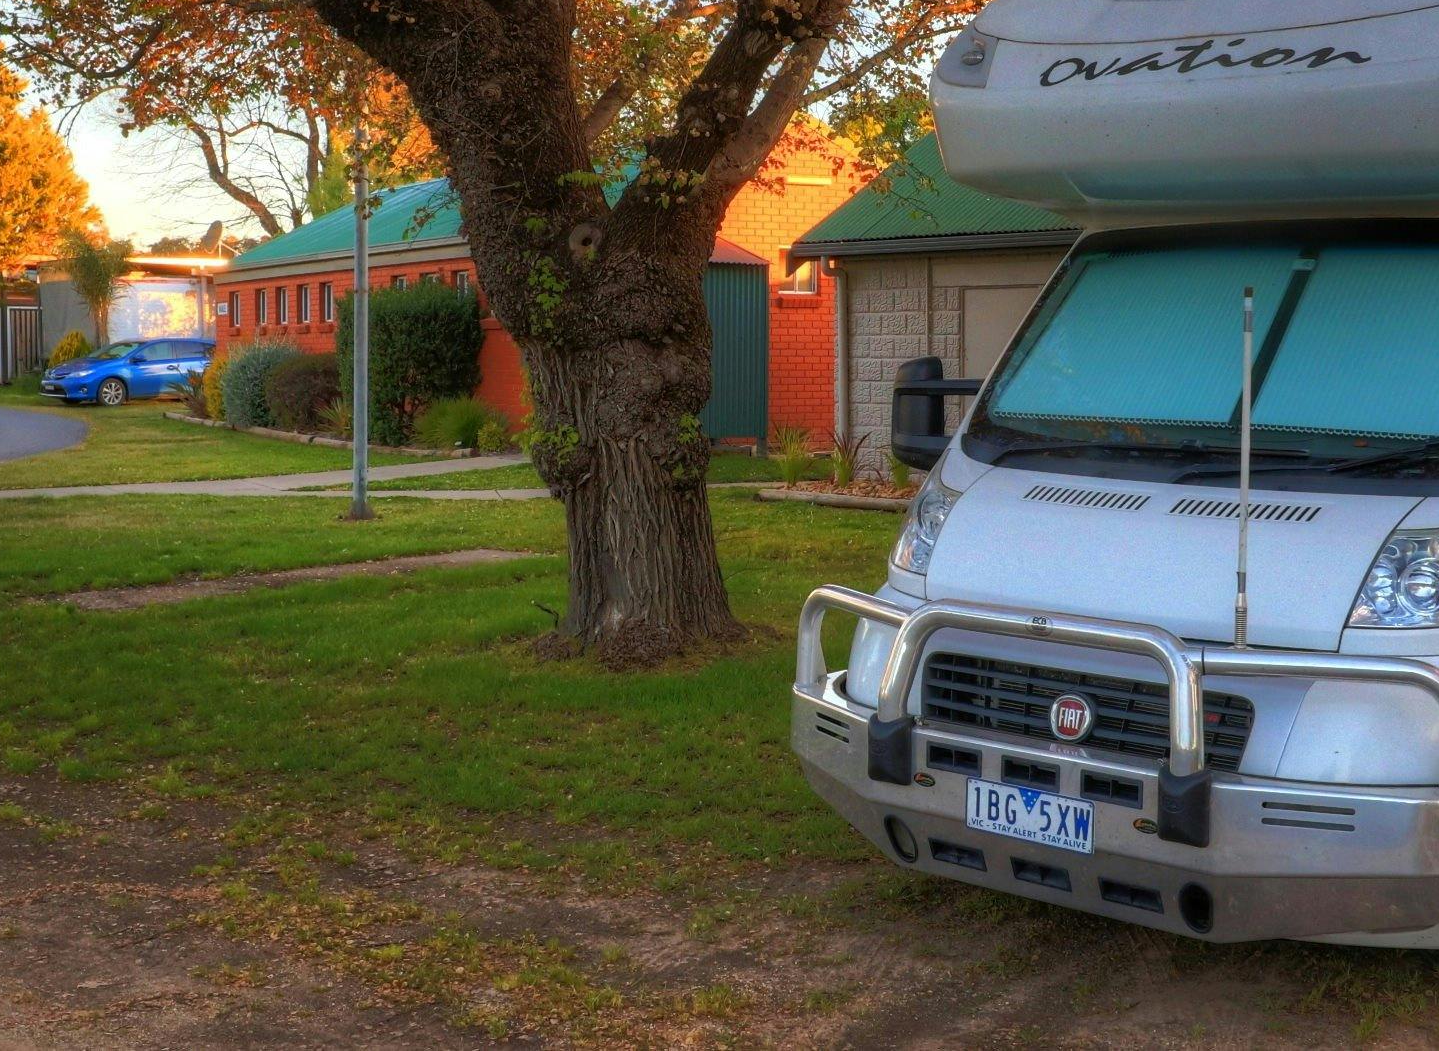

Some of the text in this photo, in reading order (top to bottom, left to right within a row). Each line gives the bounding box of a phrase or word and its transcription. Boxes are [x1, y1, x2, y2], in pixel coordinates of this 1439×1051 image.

[1058, 706, 1083, 730] FIAT
[971, 818, 984, 828] VIC
[992, 822, 1011, 832] STAY
[1013, 827, 1037, 838] ALERT
[1041, 833, 1061, 844] STAY
[1063, 839, 1087, 850] ALIVE
